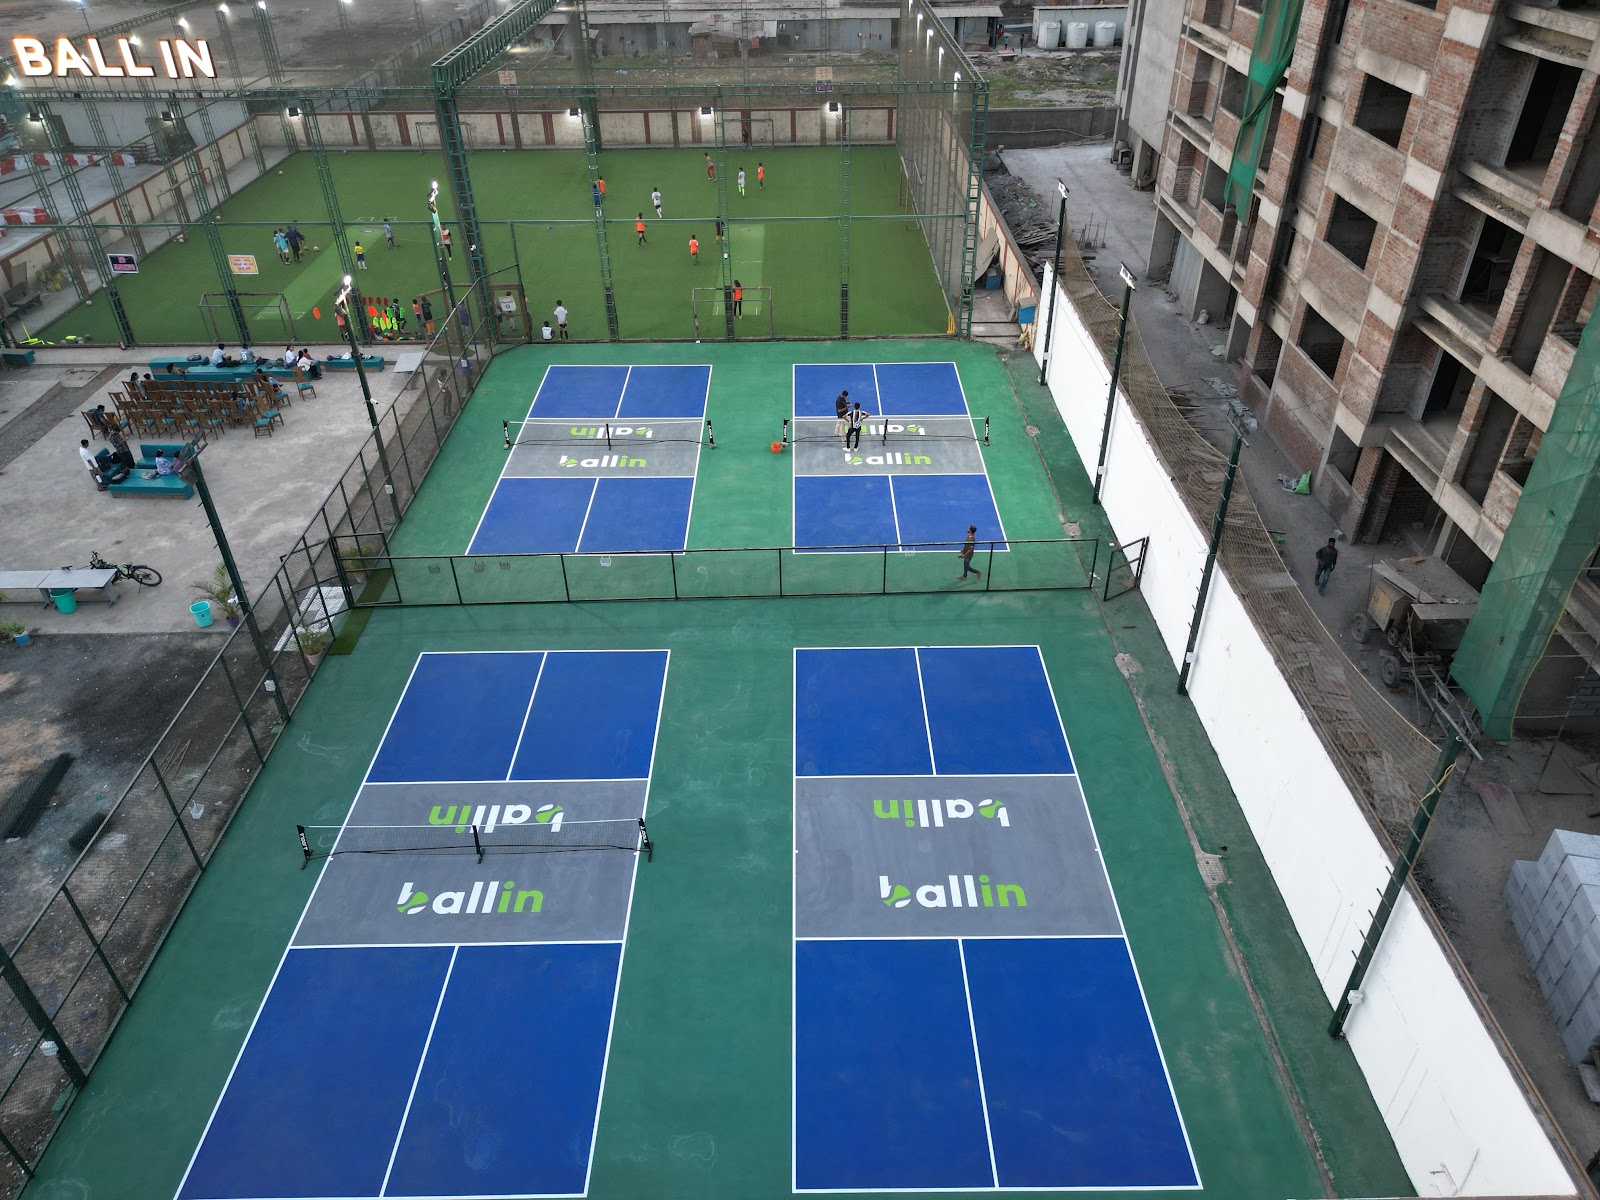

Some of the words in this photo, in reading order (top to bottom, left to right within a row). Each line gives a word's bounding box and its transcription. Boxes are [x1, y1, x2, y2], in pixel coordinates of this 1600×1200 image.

[12, 37, 155, 78] BALL
[159, 38, 216, 79] IN
[559, 455, 647, 468] ballin
[843, 452, 931, 465] ballin
[428, 804, 564, 834] ballin
[873, 799, 1011, 828] ballin
[397, 880, 544, 915] ballin
[879, 874, 1028, 908] ballin
